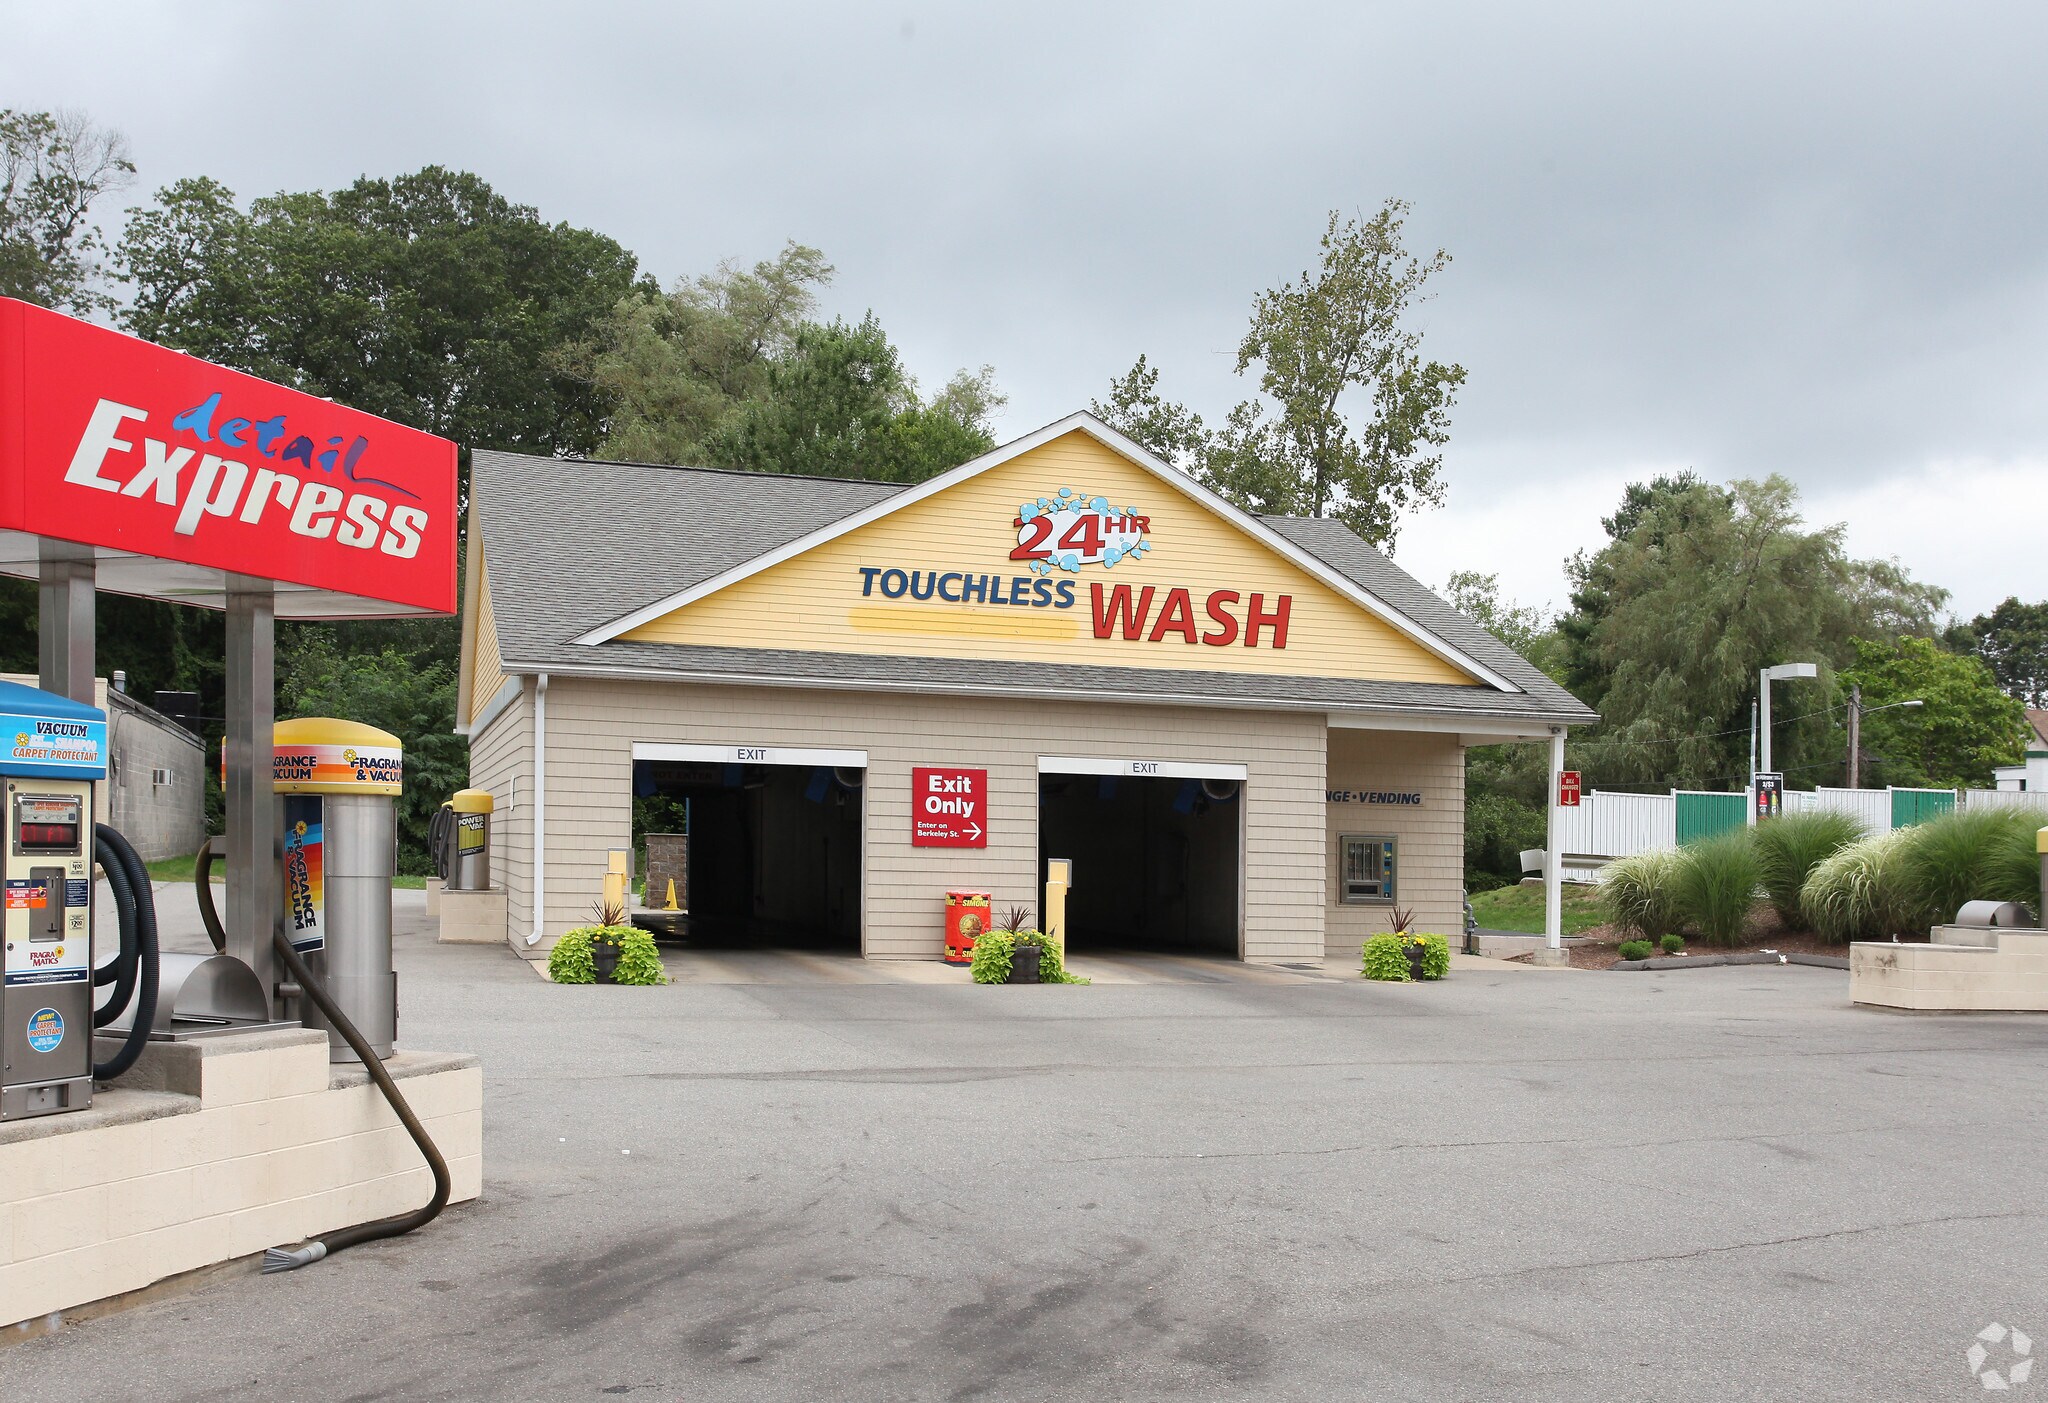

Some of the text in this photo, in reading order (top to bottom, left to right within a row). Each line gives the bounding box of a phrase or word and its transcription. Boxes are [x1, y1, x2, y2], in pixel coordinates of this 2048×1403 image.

[172, 392, 421, 499] detail
[64, 398, 428, 559] Express
[1009, 514, 1151, 560] 24 HR
[859, 567, 1076, 608] TOUCHLESS
[1090, 582, 1292, 648] WASH
[36, 722, 88, 736] VACUUM
[13, 748, 98, 761] CARPET PROTECTANT
[737, 748, 767, 760] EXIT
[350, 757, 402, 769] FRAGRAN
[1132, 762, 1159, 774] EXIT
[273, 768, 312, 779] ACUUM
[356, 769, 402, 782] & VACUU
[929, 775, 972, 793] Exit
[1359, 791, 1421, 804] VENDING
[925, 795, 975, 818] Only
[458, 815, 484, 827] POWER
[470, 822, 484, 830] VAC
[917, 821, 937, 829] Enter
[917, 829, 948, 838] Berkeley
[293, 829, 317, 928] FRAGRANCE
[289, 859, 305, 930] VACUUM
[30, 951, 56, 960] FRAGRA
[33, 957, 59, 967] MATICS
[38, 1013, 55, 1021] NEW!
[36, 1021, 56, 1029] CARPET
[30, 1028, 62, 1036] PROTECTANT
